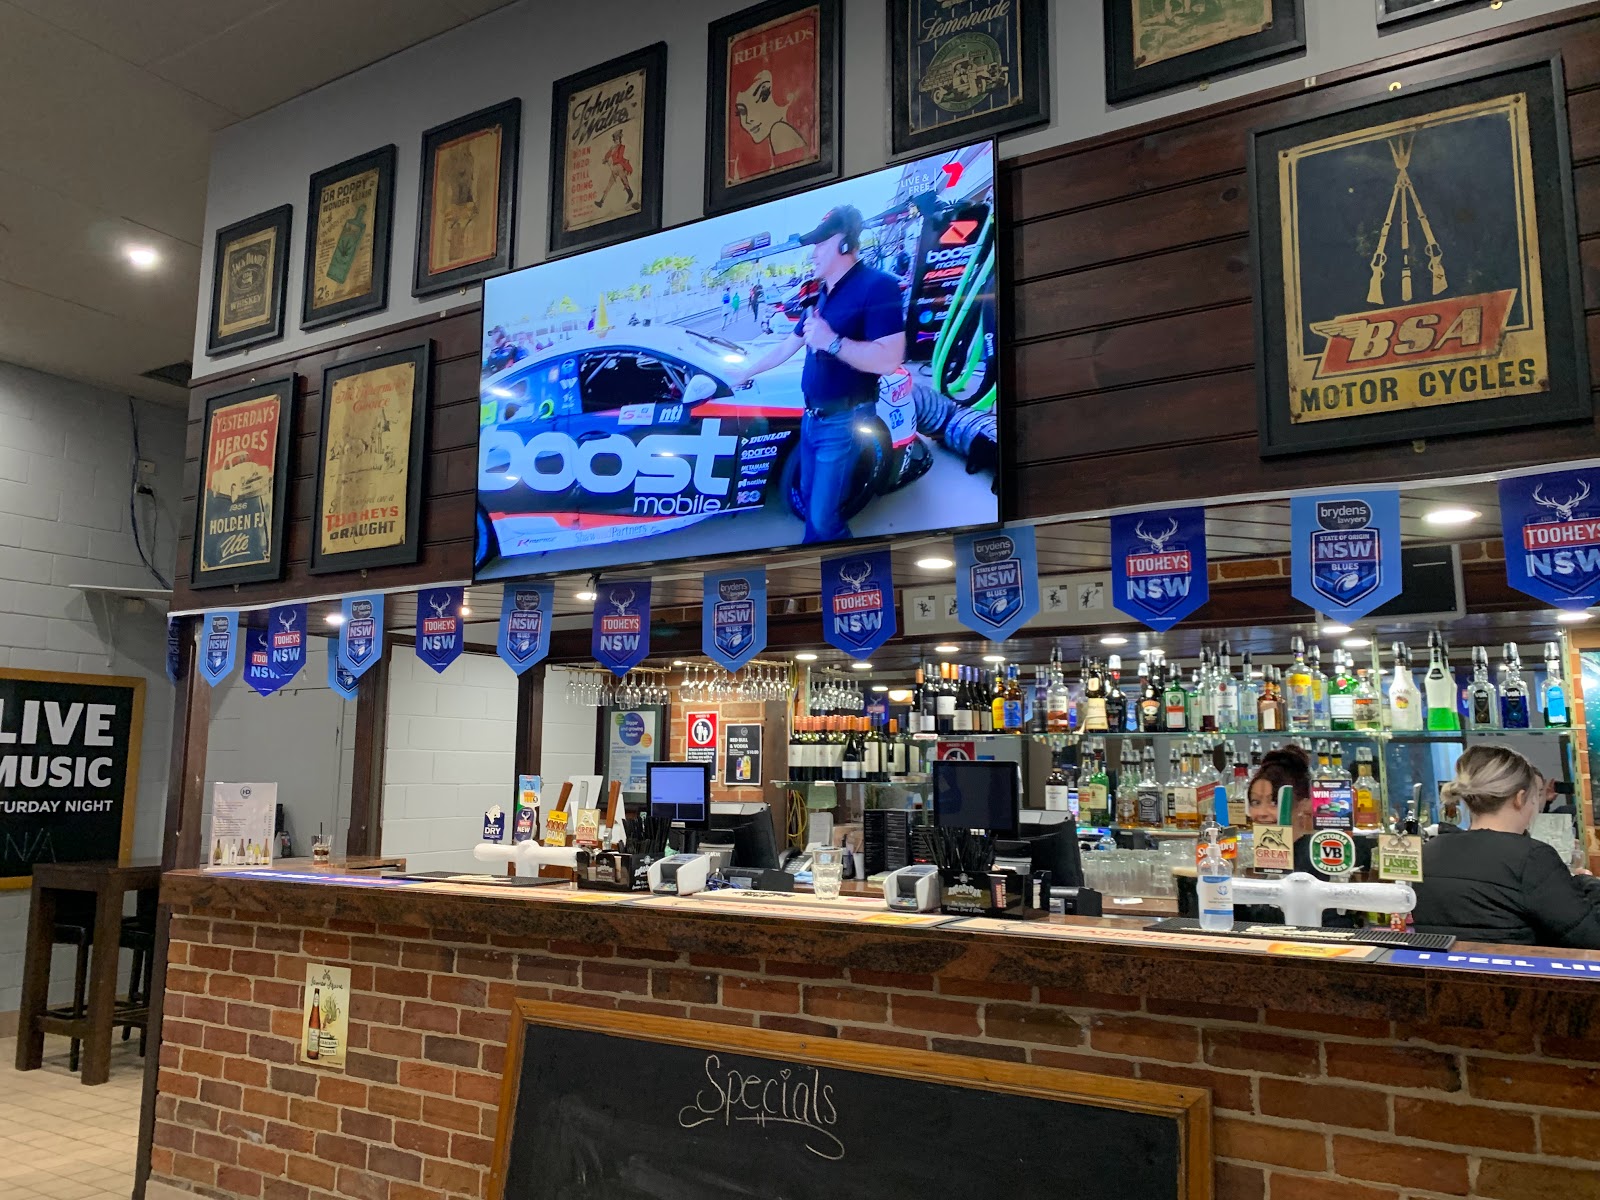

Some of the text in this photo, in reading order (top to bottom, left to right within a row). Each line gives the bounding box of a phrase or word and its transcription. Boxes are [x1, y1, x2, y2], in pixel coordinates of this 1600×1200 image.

[922, 1, 1010, 43] Lemonade
[734, 27, 814, 64] REDHEADS
[572, 82, 634, 140] Johnnie
[571, 172, 590, 183] STILL
[900, 174, 930, 188] LIVE &
[571, 180, 593, 194] GOING
[908, 182, 930, 195] FREE
[322, 190, 335, 204] DR
[322, 197, 350, 213] WONDER
[1348, 304, 1483, 362] BSA
[1300, 357, 1536, 412] MOTOR CYCLES
[216, 405, 275, 434] YESTERDAYS
[748, 430, 792, 445] DUNLOP
[214, 430, 269, 465] HEROES
[741, 446, 778, 458] sparco
[478, 418, 738, 495] boost
[632, 494, 721, 516] mobile
[1320, 504, 1367, 522] brydens
[1337, 515, 1367, 526] lawyers
[209, 511, 265, 536] HOLDEN FJ
[329, 520, 396, 541] DRAUGHT
[219, 533, 250, 556] Ute
[1319, 534, 1339, 542] STATE
[976, 538, 1011, 556] brydens
[1318, 540, 1373, 559] NSW
[1128, 555, 1189, 573] TOOHEYS
[1331, 562, 1360, 572] BLUES
[975, 571, 1017, 588] NSW
[986, 588, 1007, 599] BLUES
[1126, 576, 1192, 600] NSW
[835, 593, 880, 610] TOOHEYS
[718, 608, 750, 623] NSW
[834, 611, 883, 635] NSW
[350, 625, 373, 638] NSW
[424, 618, 455, 632] TOOHEYS
[512, 618, 539, 630] NSW
[603, 617, 639, 632] TOOHEYS
[209, 639, 228, 650] NSW
[274, 633, 300, 646] TOOHEYS
[422, 634, 456, 651] NSW
[601, 634, 640, 651] NSW
[272, 647, 300, 663] NSW
[0, 698, 116, 747] LIVE
[1312, 790, 1329, 799] WIN
[65, 800, 113, 812] NIGHT
[484, 827, 502, 835] DRY
[546, 829, 564, 839] GOLD
[1314, 833, 1348, 846] VICTORIA
[1255, 848, 1290, 859] GREAT
[1322, 846, 1343, 859] VB
[1318, 862, 1348, 872] BITTER
[1383, 857, 1418, 869] LASHES
[1447, 955, 1535, 968] FEEL
[696, 1054, 837, 1126] Specials
